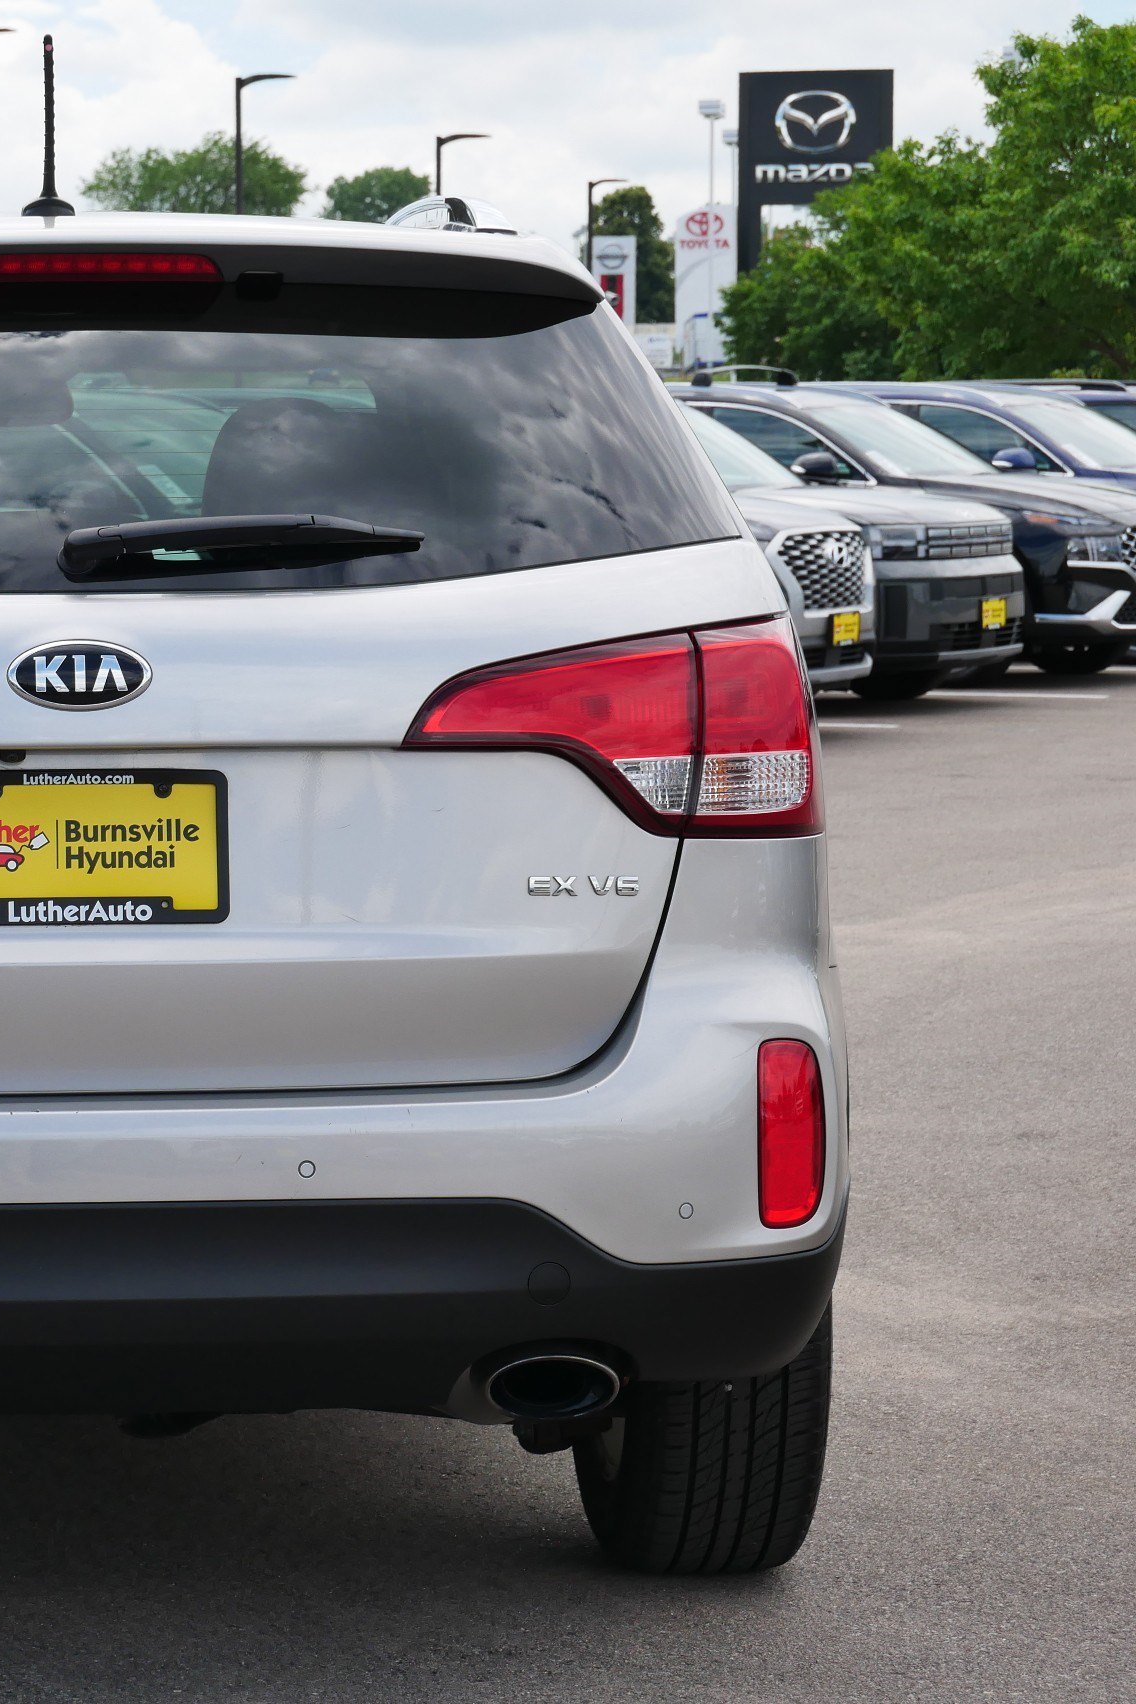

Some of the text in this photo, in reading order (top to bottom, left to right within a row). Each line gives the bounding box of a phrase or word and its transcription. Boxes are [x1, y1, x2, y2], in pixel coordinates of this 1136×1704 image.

[33, 655, 128, 692] KIA
[23, 773, 135, 785] LutherAuto.com
[65, 818, 200, 843] Burnsville
[65, 844, 175, 875] Hyundai
[528, 875, 639, 896] EX V6
[8, 900, 153, 923] LutherAuto
